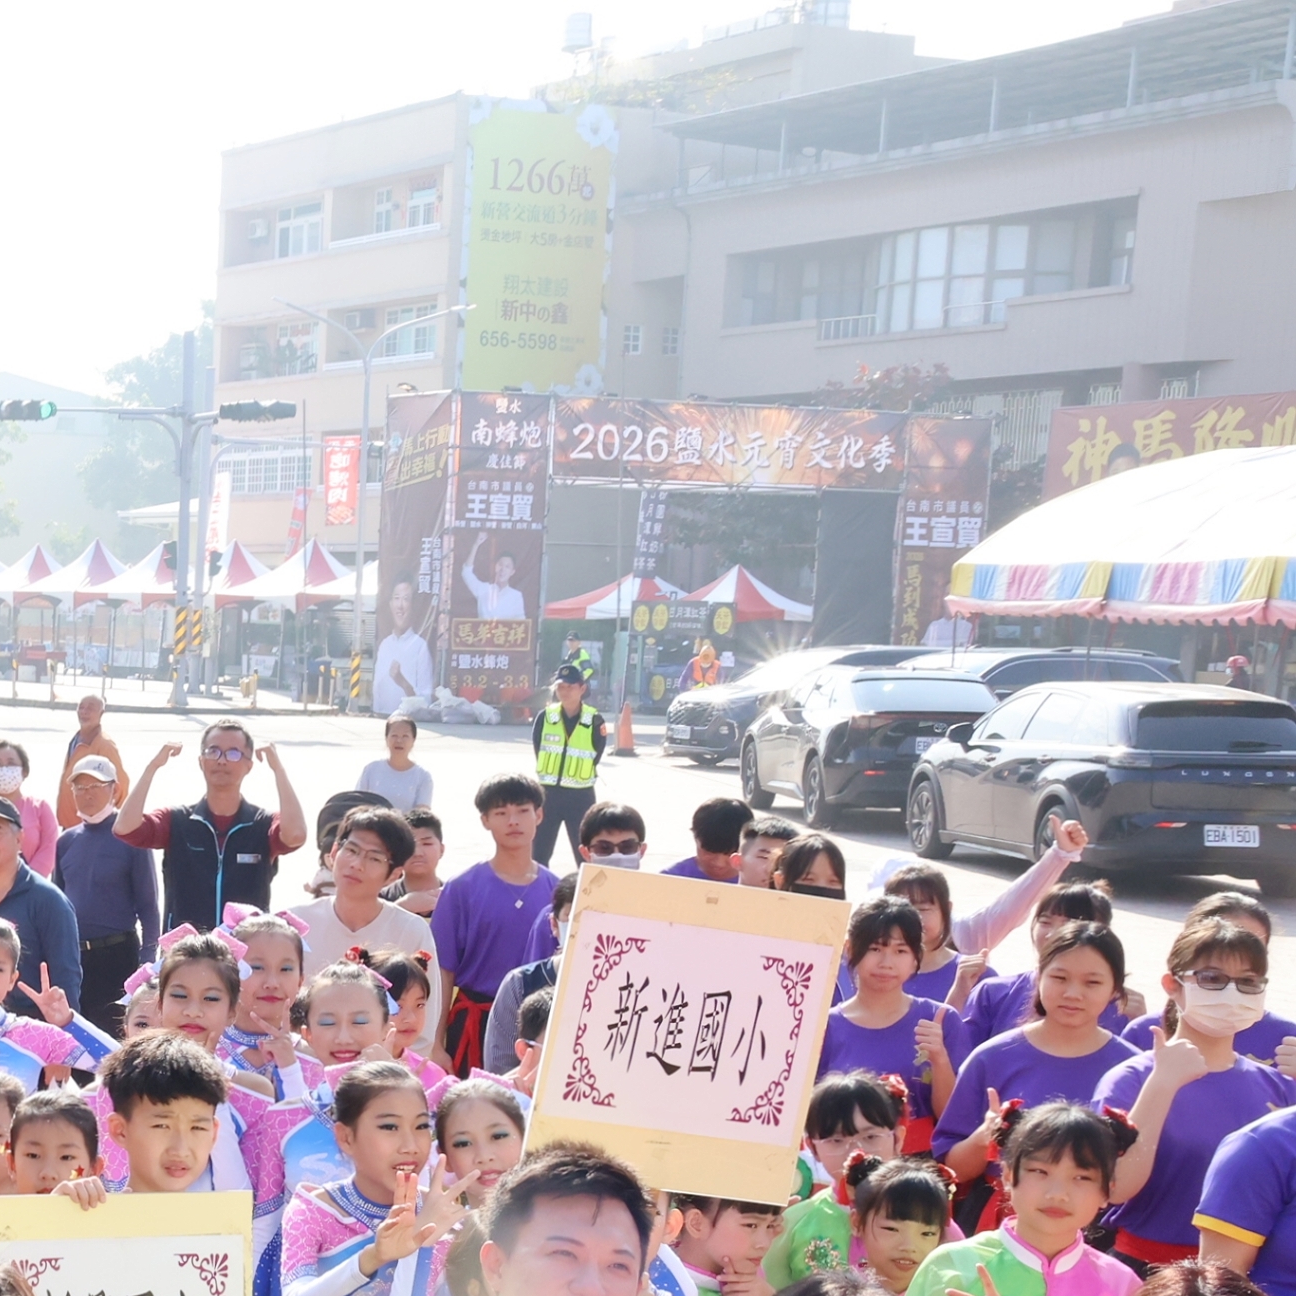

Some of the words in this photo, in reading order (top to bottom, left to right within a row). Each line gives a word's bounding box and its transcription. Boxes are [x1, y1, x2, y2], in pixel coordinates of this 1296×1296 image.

[503, 275, 568, 297] 翔太建設
[501, 300, 568, 324] 新中の鑫
[479, 330, 557, 351] 656-5598
[471, 419, 542, 448] 南蜂炮
[1062, 405, 1296, 486] 神馬降
[569, 422, 896, 473] 2026鹽水元宵文化季
[486, 453, 526, 469] 慶佳節
[1206, 830, 1257, 843] EBA-1501
[603, 970, 767, 1087] 新進國小
